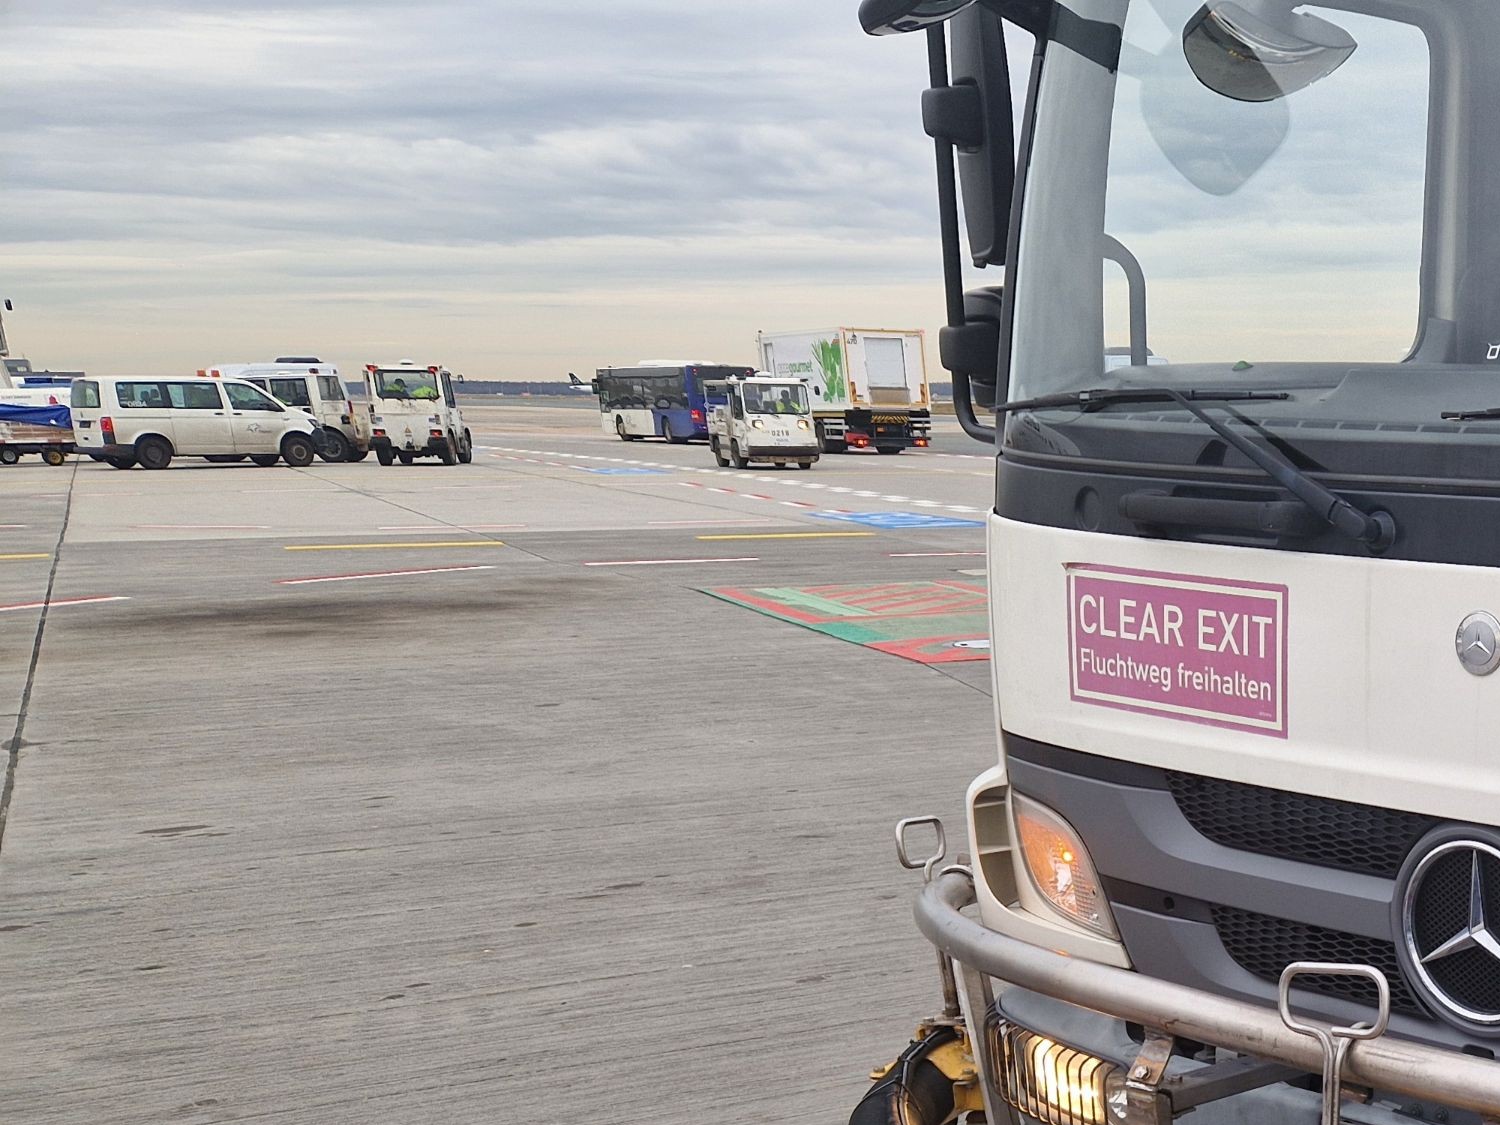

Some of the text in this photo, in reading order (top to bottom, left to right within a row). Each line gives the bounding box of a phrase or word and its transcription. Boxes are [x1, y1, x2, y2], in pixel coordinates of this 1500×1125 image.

[1079, 593, 1273, 659] CLEAR EXIT
[1080, 647, 1272, 702] Fluchtweg freihalten
